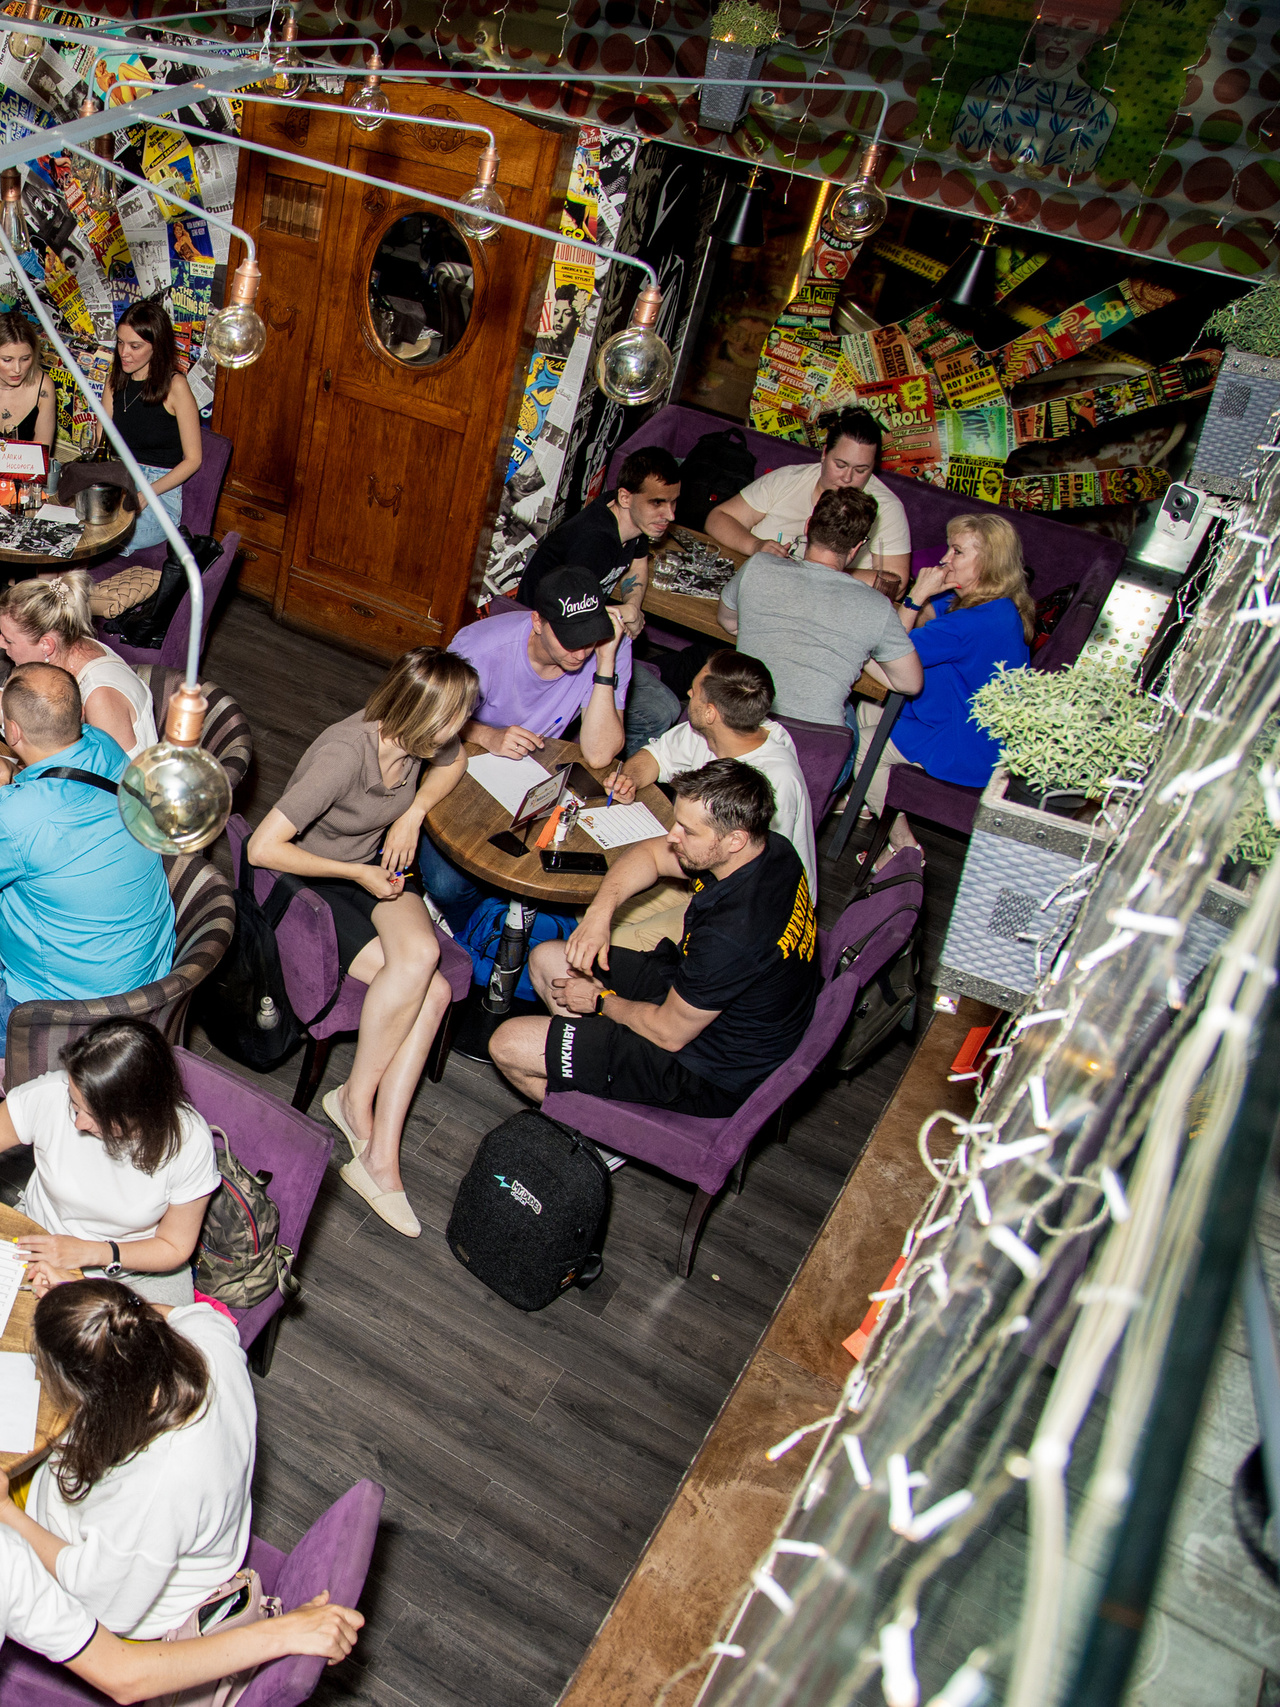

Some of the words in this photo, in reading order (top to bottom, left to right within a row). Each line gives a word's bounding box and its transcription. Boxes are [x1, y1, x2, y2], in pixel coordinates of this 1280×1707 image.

[772, 347, 800, 362] JOHNSON
[780, 341, 801, 354] BUDDY
[883, 347, 898, 379] BERRY
[892, 344, 910, 376] CHUCK
[946, 360, 962, 371] RAY
[778, 362, 807, 379] NUTMEGS
[940, 364, 974, 382] CHARLES
[946, 379, 962, 390] ROY
[965, 368, 991, 384] AYERS
[858, 393, 898, 411] ROCK
[891, 409, 932, 428] ROLL
[2, 453, 24, 461] ЛАПКИ
[949, 464, 984, 480] COUNT
[945, 477, 982, 498] BASIE
[559, 593, 599, 618] Yandex
